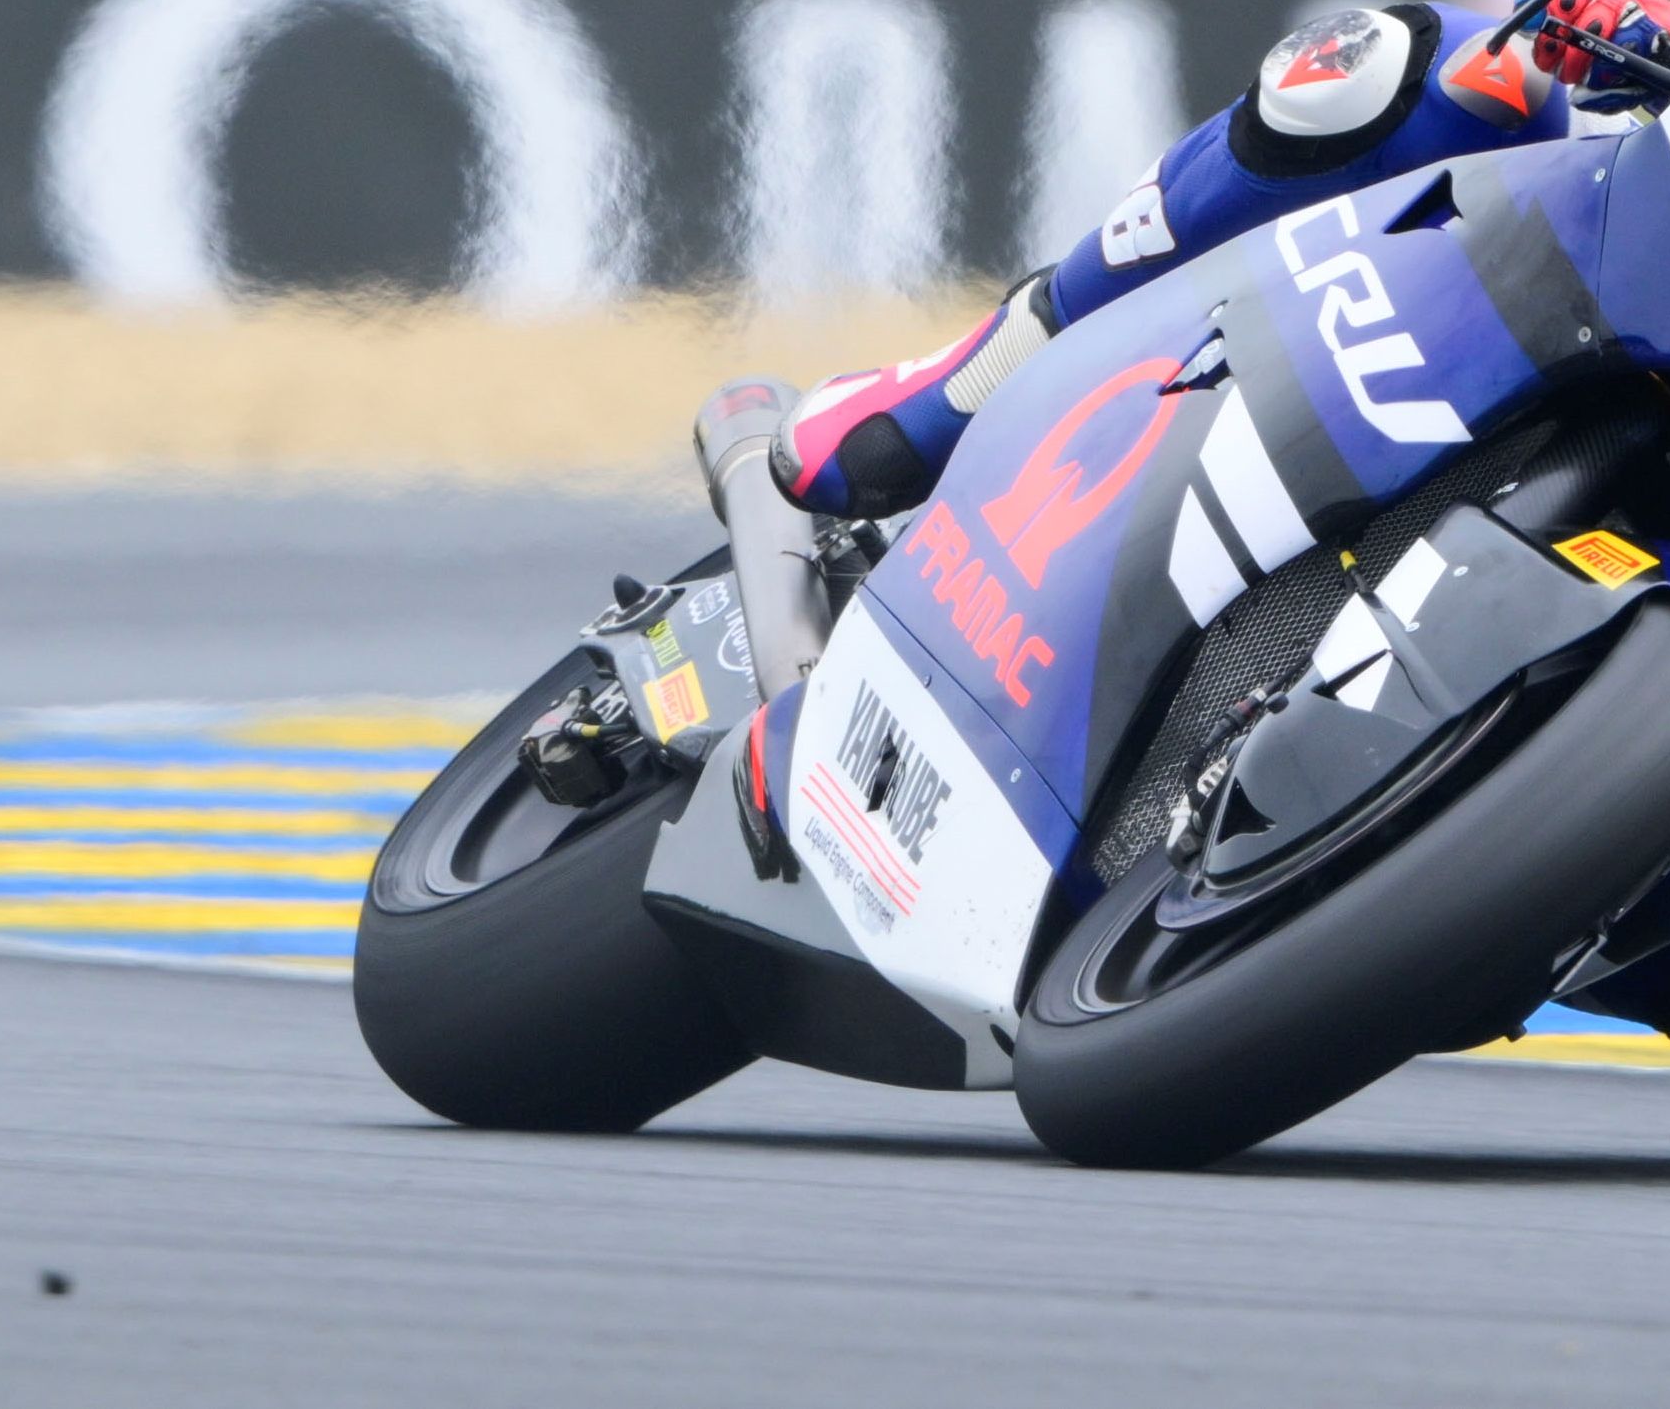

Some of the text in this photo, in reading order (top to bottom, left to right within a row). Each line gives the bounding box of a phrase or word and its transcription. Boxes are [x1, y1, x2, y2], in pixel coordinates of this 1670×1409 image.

[1275, 195, 1474, 443] CRU
[905, 502, 1055, 709] PRAMAC
[1568, 536, 1642, 581] PIRELLI
[804, 815, 896, 933] Liquid Engine Component
